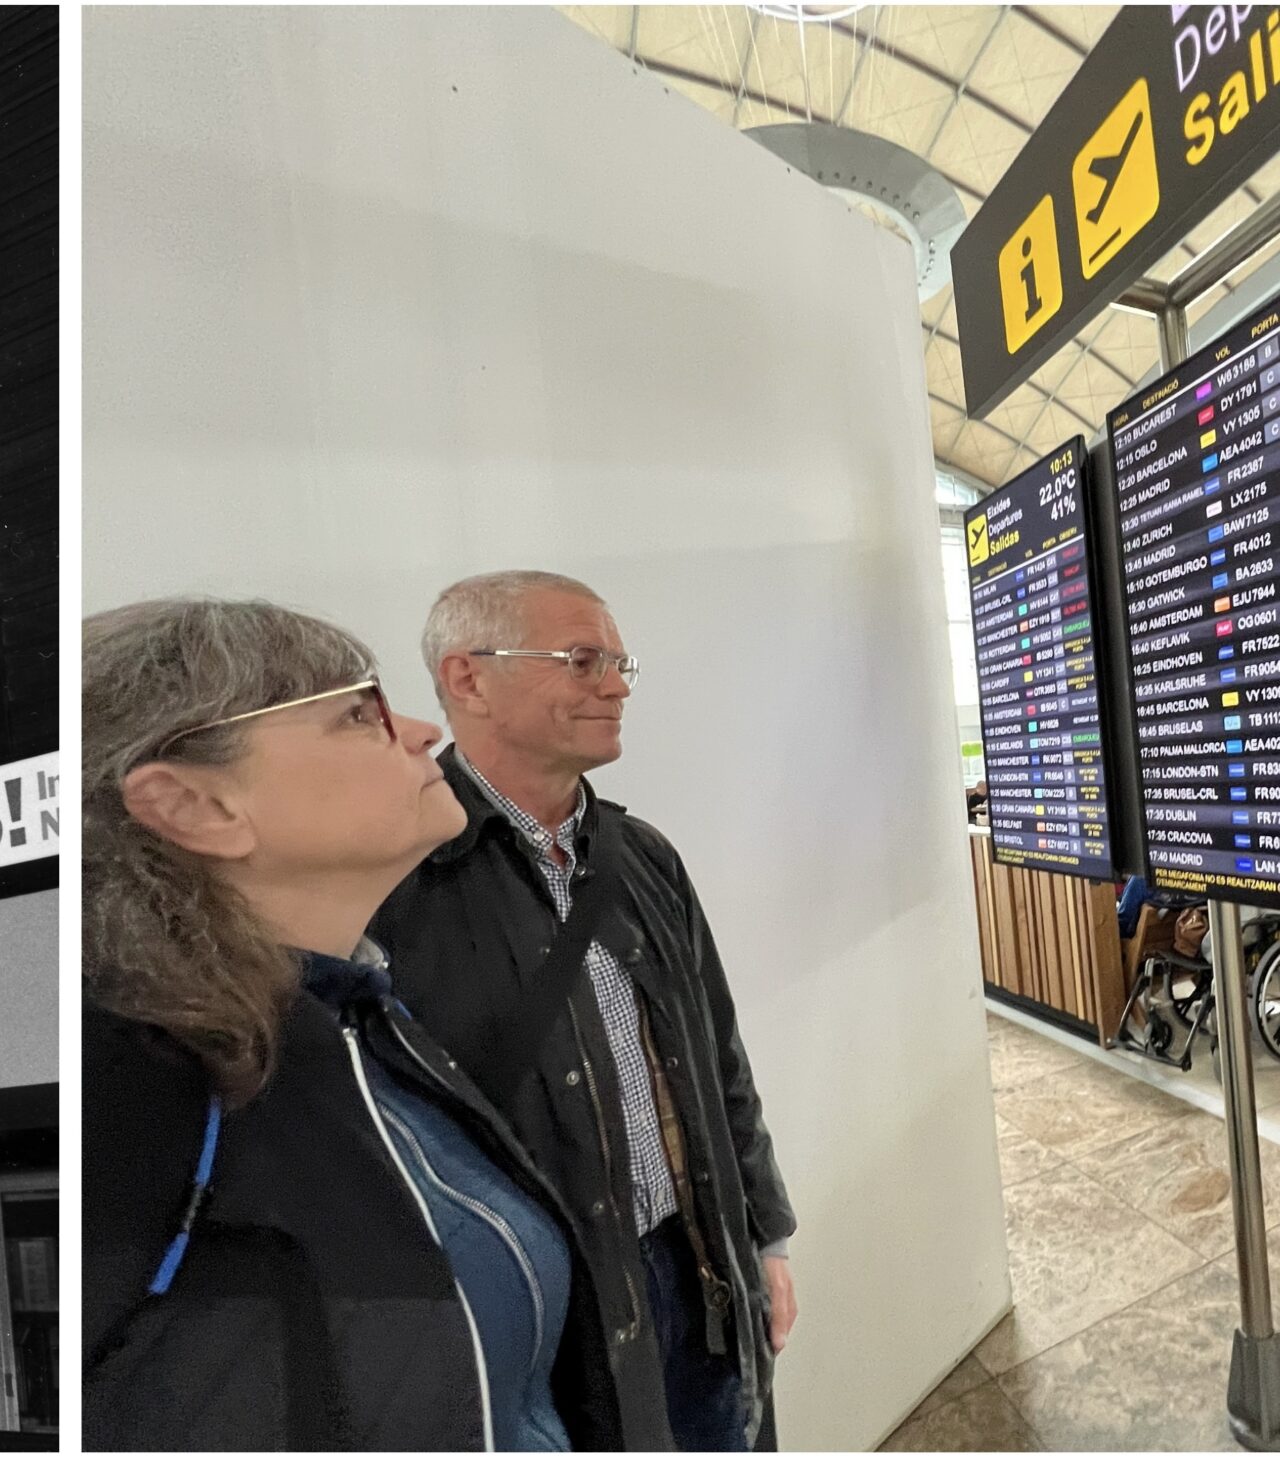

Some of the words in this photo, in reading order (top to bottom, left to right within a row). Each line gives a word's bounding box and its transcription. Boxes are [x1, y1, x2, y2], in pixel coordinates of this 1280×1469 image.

[1133, 403, 1176, 440] BUCAREST
[1135, 439, 1157, 461] OSLO
[1050, 450, 1073, 475] 10:13
[1136, 446, 1188, 483] BARCELONA
[1138, 478, 1170, 504] MADRID
[1051, 492, 1076, 521] 41%
[1142, 522, 1173, 547] ZURICH
[1143, 544, 1176, 567] MADRID
[1145, 555, 1208, 588] GOTEMBURGO
[1147, 586, 1185, 609] GATWICK
[1149, 604, 1203, 630] AMSTERDAM
[1150, 631, 1190, 651] KEFLAVIK
[1152, 651, 1203, 673] EINDHOVEN
[1154, 673, 1207, 694] KARLSRUHE
[1156, 696, 1210, 715] BARCELONA
[1158, 720, 1204, 736] BRUSELAS
[1160, 744, 1184, 757] PALMA
[1183, 741, 1226, 755] MALLORCA
[1161, 765, 1219, 779] LONDON-STN
[1163, 787, 1219, 800] BRUSEL-CRL
[1165, 809, 1197, 822] DUBLIN
[1167, 830, 1213, 845] CRACOVIA
[1169, 852, 1203, 866] MADRID
